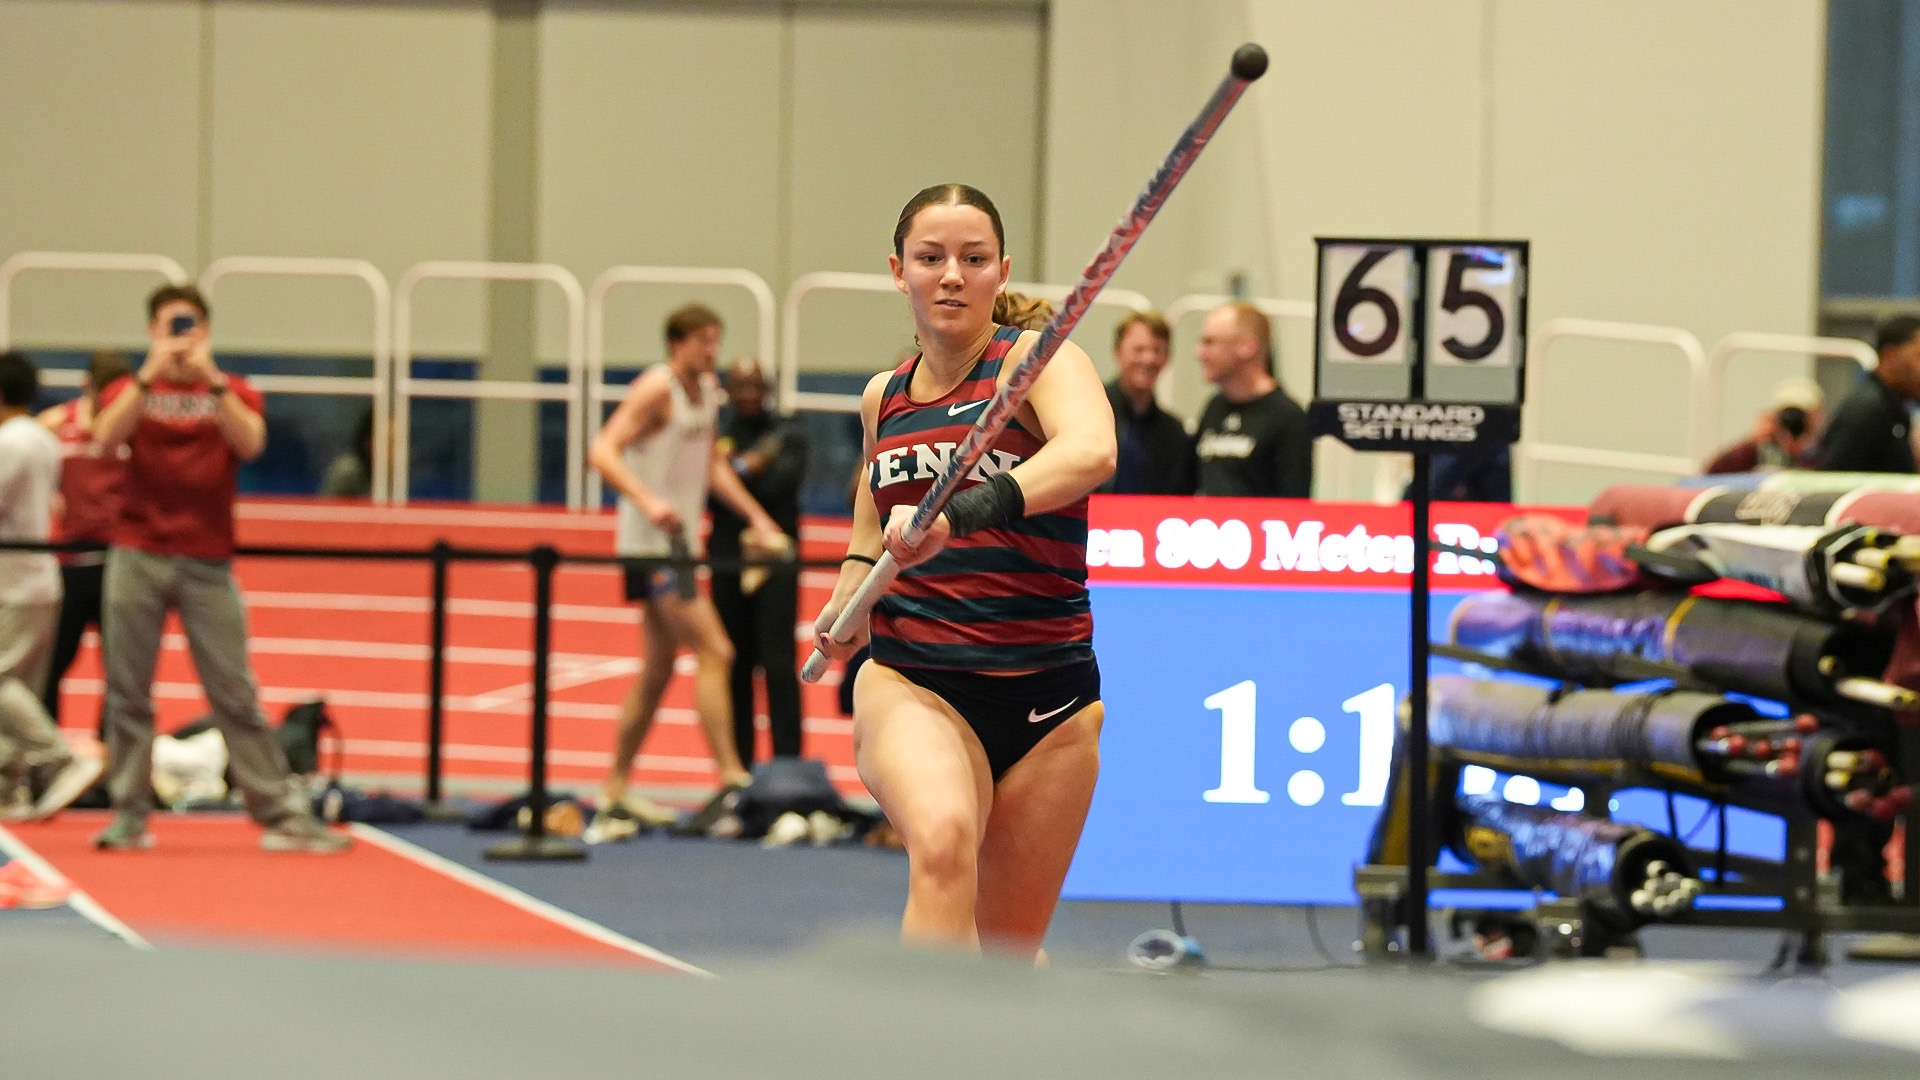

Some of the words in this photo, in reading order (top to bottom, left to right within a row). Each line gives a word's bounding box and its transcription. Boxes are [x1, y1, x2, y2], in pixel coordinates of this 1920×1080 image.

[1337, 402, 1486, 426] STANDARD
[1342, 421, 1478, 442] SETTINGS
[868, 441, 1021, 489] ENN
[1085, 528, 1146, 568] en
[1155, 517, 1252, 570] 800
[1202, 679, 1396, 807] 1:1
